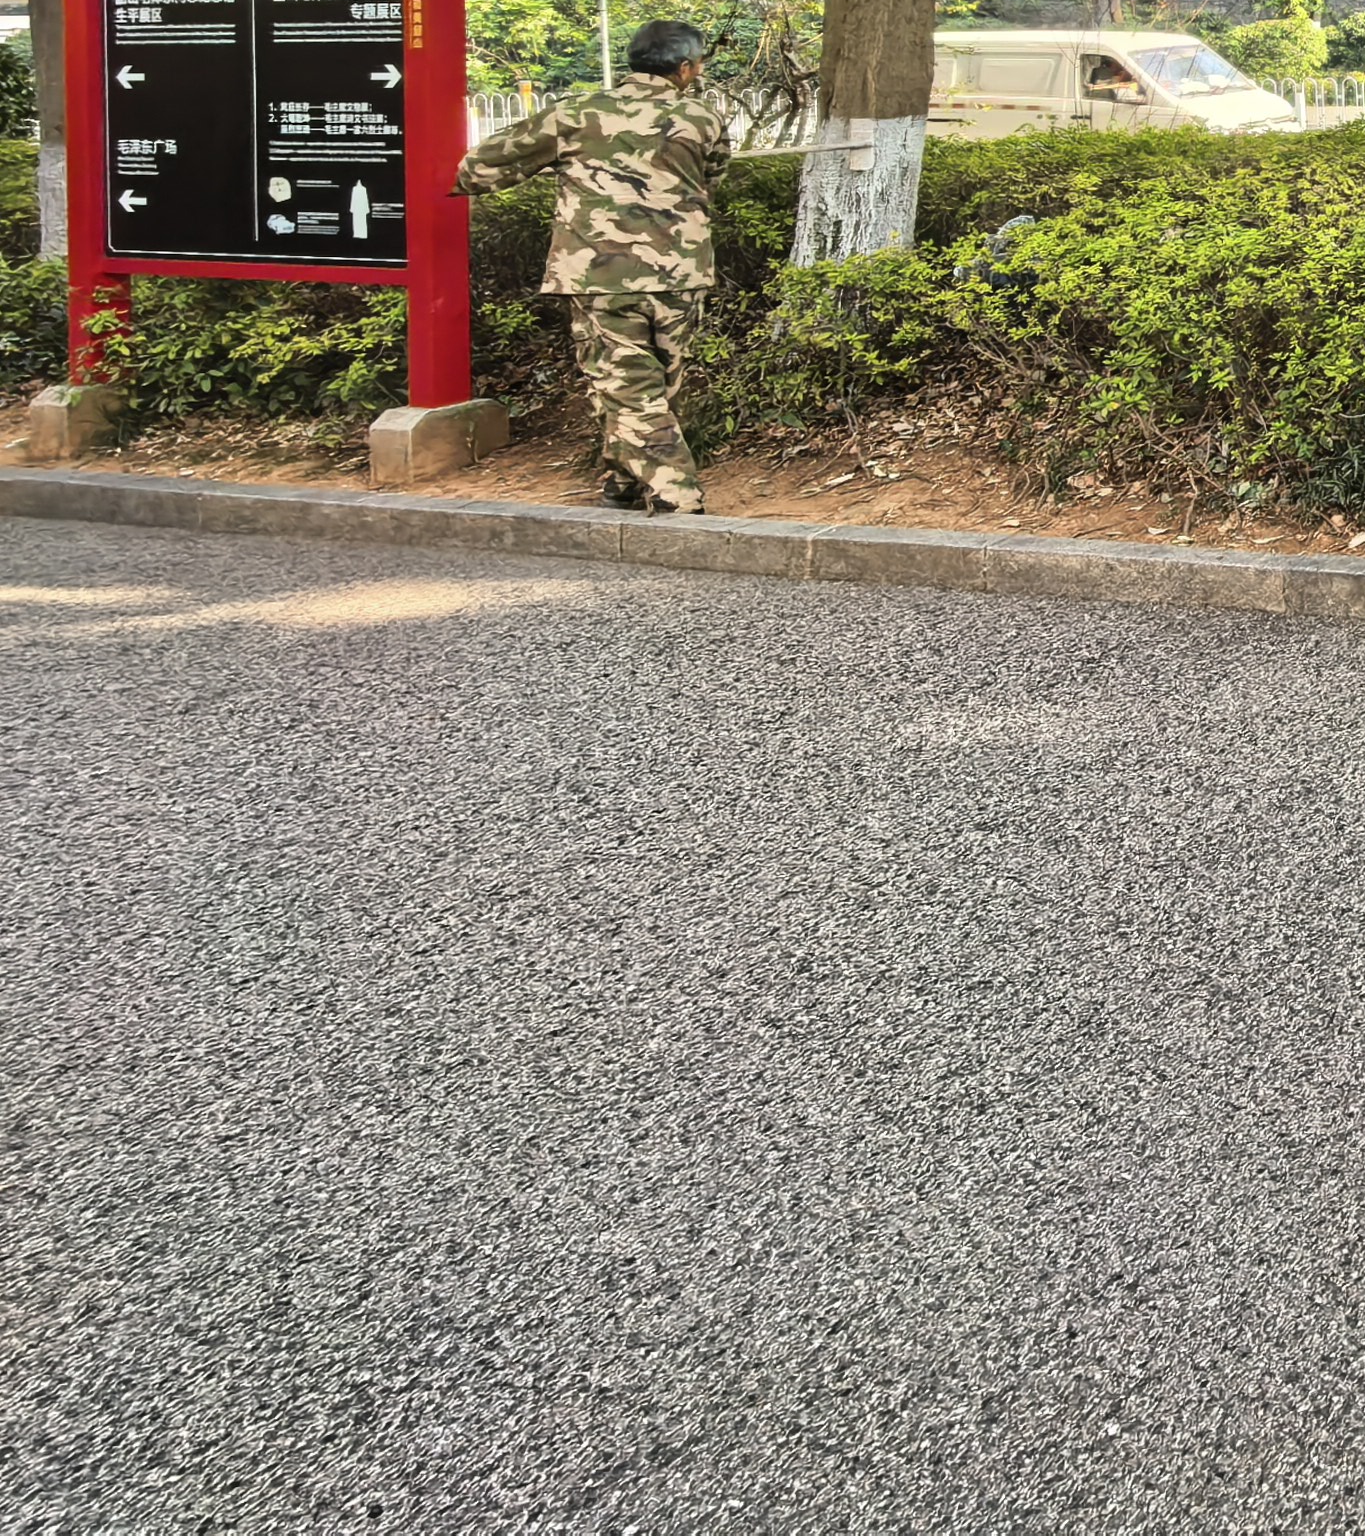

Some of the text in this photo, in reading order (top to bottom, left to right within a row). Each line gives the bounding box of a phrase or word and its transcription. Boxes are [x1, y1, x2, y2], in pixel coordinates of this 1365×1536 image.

[350, 3, 402, 19] 专题展区
[117, 139, 177, 154] 毛泽东广场
